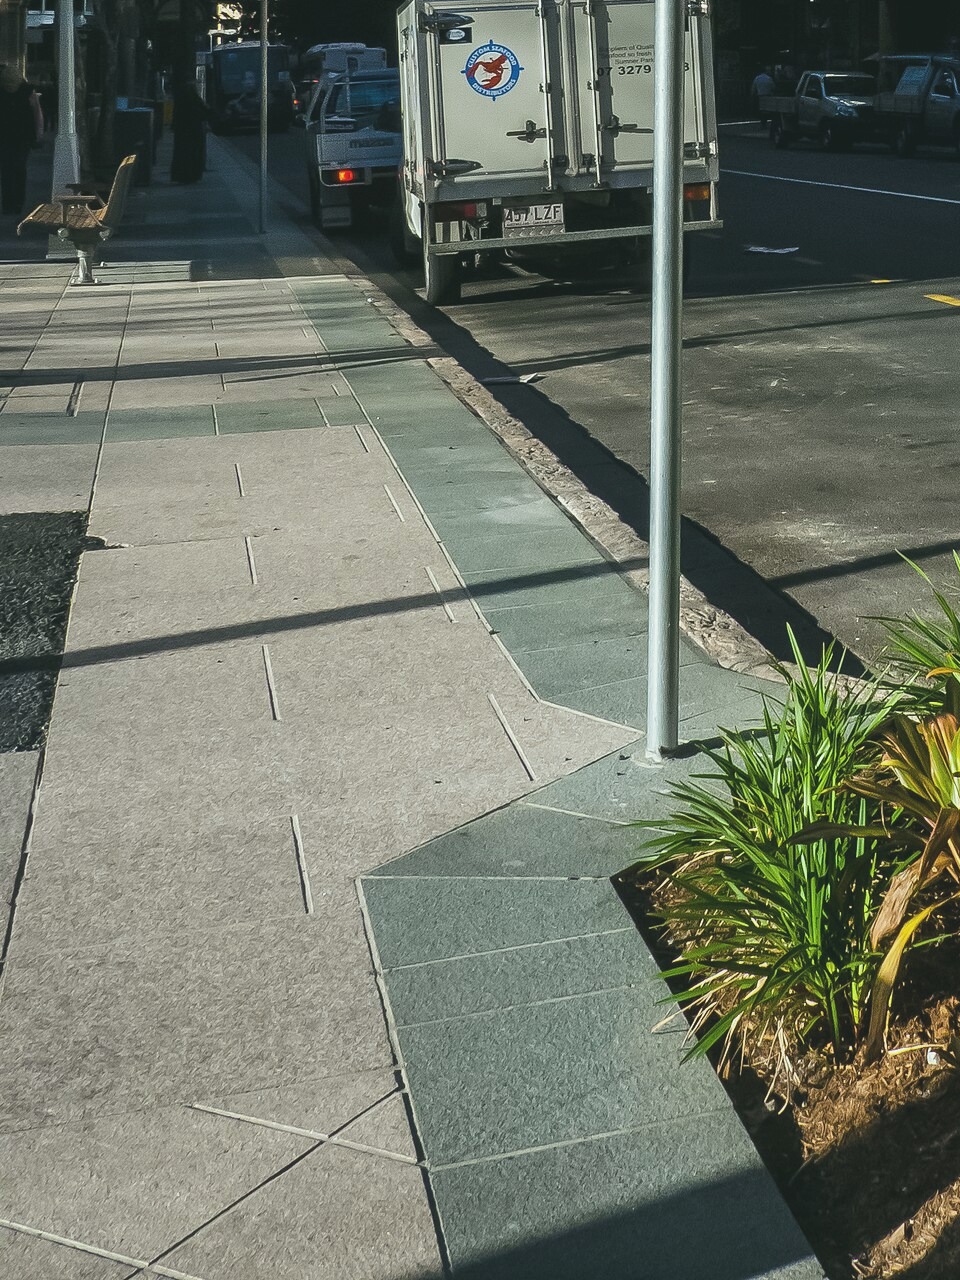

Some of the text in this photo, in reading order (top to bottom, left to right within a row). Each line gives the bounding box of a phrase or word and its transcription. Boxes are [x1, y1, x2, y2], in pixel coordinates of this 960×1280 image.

[467, 45, 517, 67] CUSTOM SEAFOOD
[597, 64, 652, 77] 07 3279
[472, 79, 516, 96] DISTRIBUTORS
[534, 205, 562, 221] LZF
